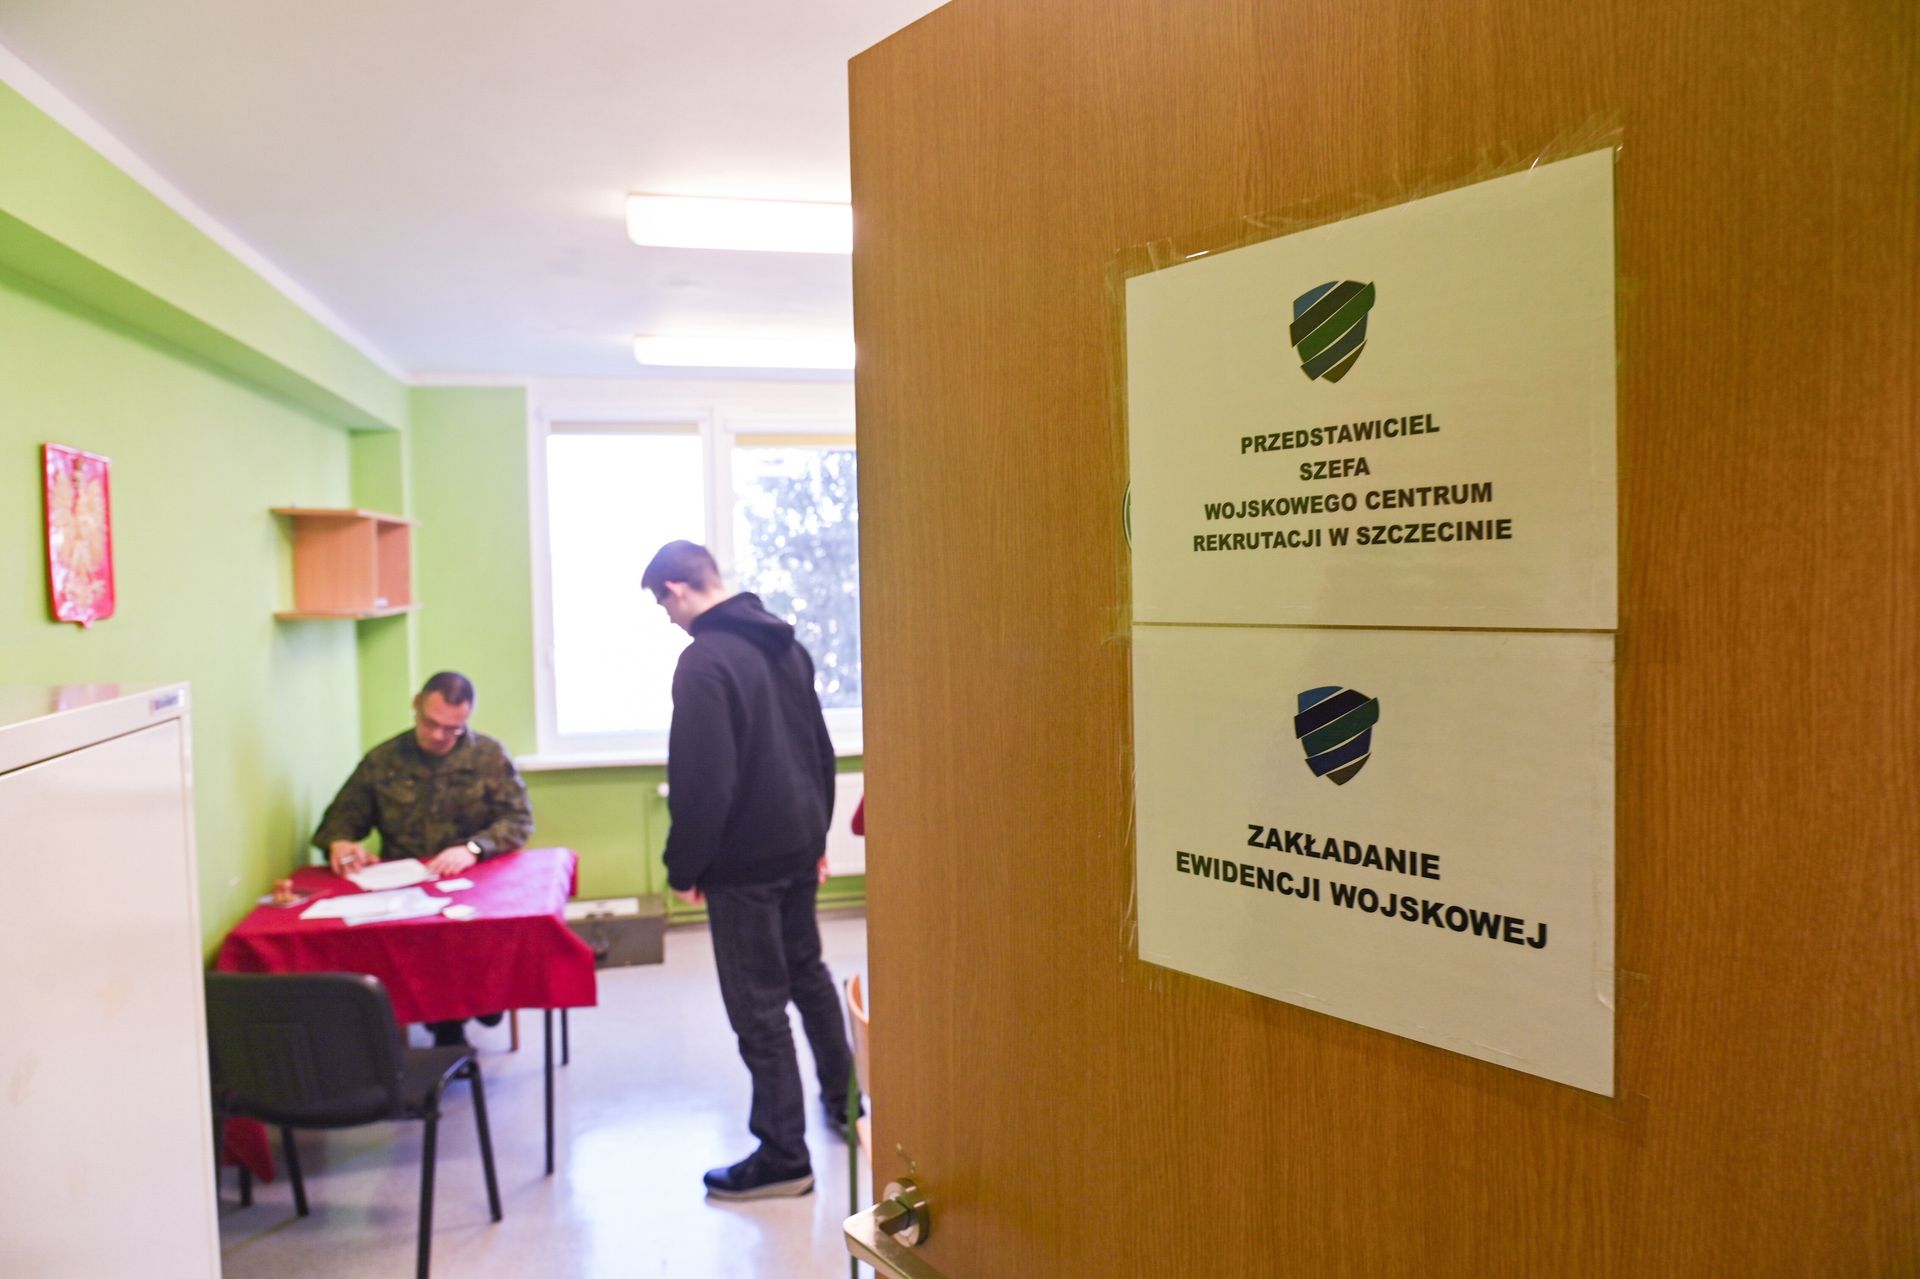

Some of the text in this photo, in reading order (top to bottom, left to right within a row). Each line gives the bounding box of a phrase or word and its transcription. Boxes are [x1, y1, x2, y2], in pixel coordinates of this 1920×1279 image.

[1241, 413, 1440, 455] PRZEDSTAWICIEL
[1299, 457, 1371, 481] SZEFA
[1204, 481, 1493, 521] WOJSKOWEGO CENTRUM
[1193, 518, 1513, 552] REKRUTACJI W SZCZECINIE
[1247, 823, 1441, 881] ZAKŁADANIE
[1176, 850, 1547, 950] EWIDENCJI WOJSKOWEJ
